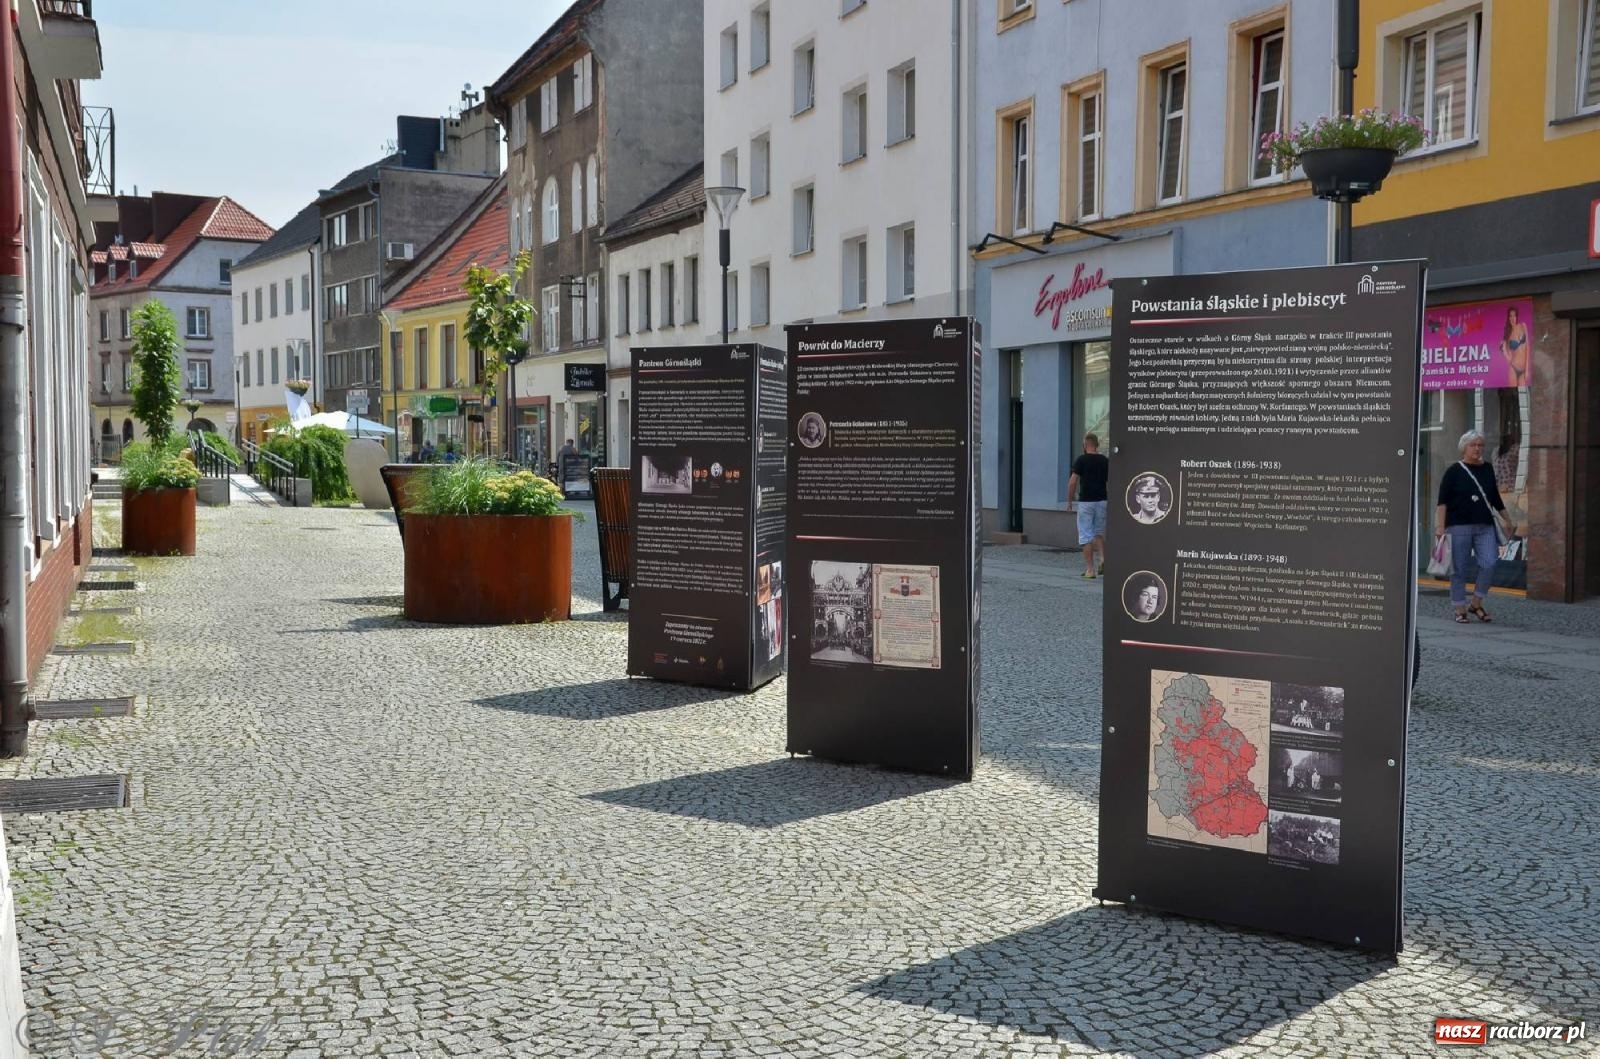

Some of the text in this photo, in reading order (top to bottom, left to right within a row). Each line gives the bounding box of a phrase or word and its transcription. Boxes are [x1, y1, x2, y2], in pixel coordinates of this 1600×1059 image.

[1034, 263, 1114, 330] Ergoline
[1131, 292, 1348, 313] Powstania śląskie i plebiscyt
[1231, 334, 1252, 343] Górny
[1254, 333, 1272, 342] Śląsk
[1319, 332, 1344, 340] trakcie
[1345, 331, 1353, 339] III
[1355, 332, 1392, 340] powstania
[798, 338, 885, 351] Powrót do Macierzy
[1199, 347, 1230, 355] nazywane
[1231, 345, 1243, 355] jest
[1308, 344, 1328, 353] wojną
[1420, 344, 1491, 364] BIELIZNA
[1128, 358, 1141, 367] Jego
[1184, 359, 1215, 367] przyczyną
[1217, 357, 1231, 366] była
[1276, 356, 1287, 364] dla
[1290, 356, 1312, 365] strony
[1315, 356, 1343, 365] polskiej
[1345, 355, 1392, 364] interpretacja
[1300, 367, 1339, 376] wytyczenie
[1458, 365, 1489, 375] Męska
[1127, 380, 1147, 389] granic
[1149, 380, 1176, 389] Górnego
[1340, 391, 1354, 400] tym
[1355, 391, 1391, 399] powstaniu
[1127, 403, 1138, 412] był
[1180, 403, 1196, 411] który
[1197, 403, 1208, 412] był
[1232, 403, 1259, 412] ochrony
[1318, 403, 1361, 411] powstaniach
[1362, 403, 1391, 411] śląskich
[1245, 414, 1260, 422] nich
[1278, 414, 1297, 422] Maria
[1258, 427, 1285, 435] pomocy
[1286, 427, 1312, 435] rannym
[1180, 459, 1281, 470] Robert Oszek (1896-1938)
[1177, 550, 1288, 564] Maria Kujawska (1893-1948)
